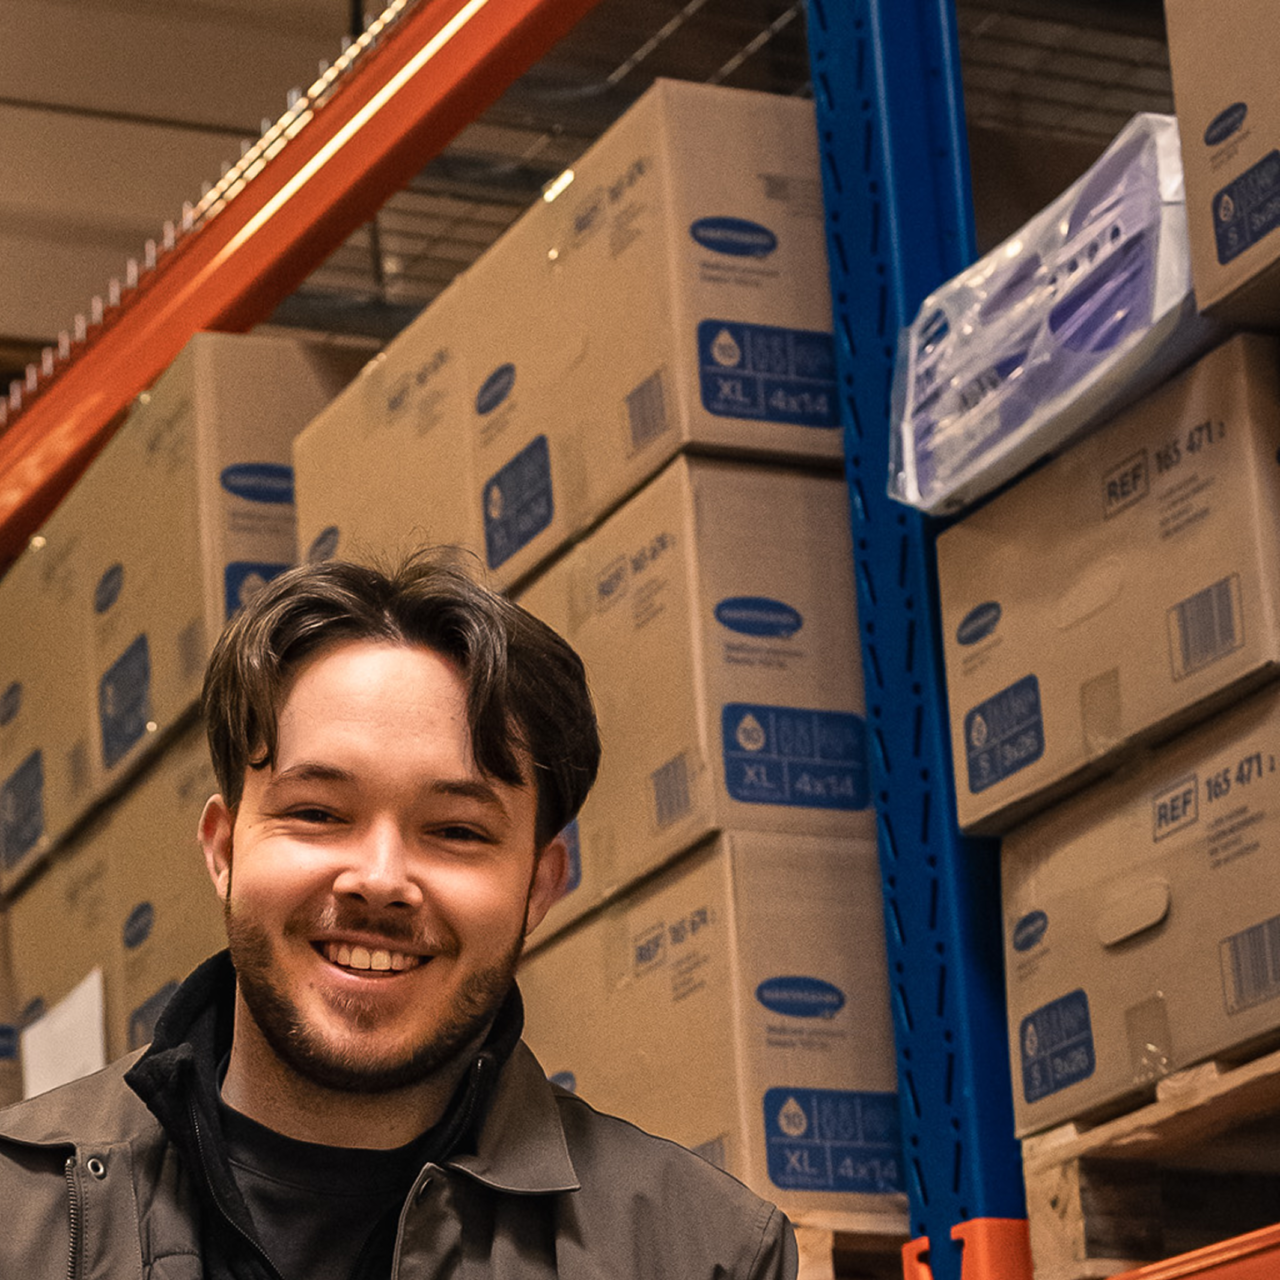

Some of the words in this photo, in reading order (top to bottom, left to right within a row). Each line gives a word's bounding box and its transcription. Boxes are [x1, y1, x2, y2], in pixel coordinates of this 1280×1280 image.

[718, 378, 751, 403] XL
[1106, 462, 1142, 507] REF
[1155, 440, 1181, 473] 165
[1186, 420, 1214, 454] 471
[741, 762, 776, 789] XL
[795, 772, 855, 798] 4x14
[1157, 788, 1193, 828] REF
[1206, 767, 1232, 803] 165
[1235, 752, 1262, 786] 471
[784, 1150, 818, 1174] XL
[839, 1158, 898, 1181] 4x14
